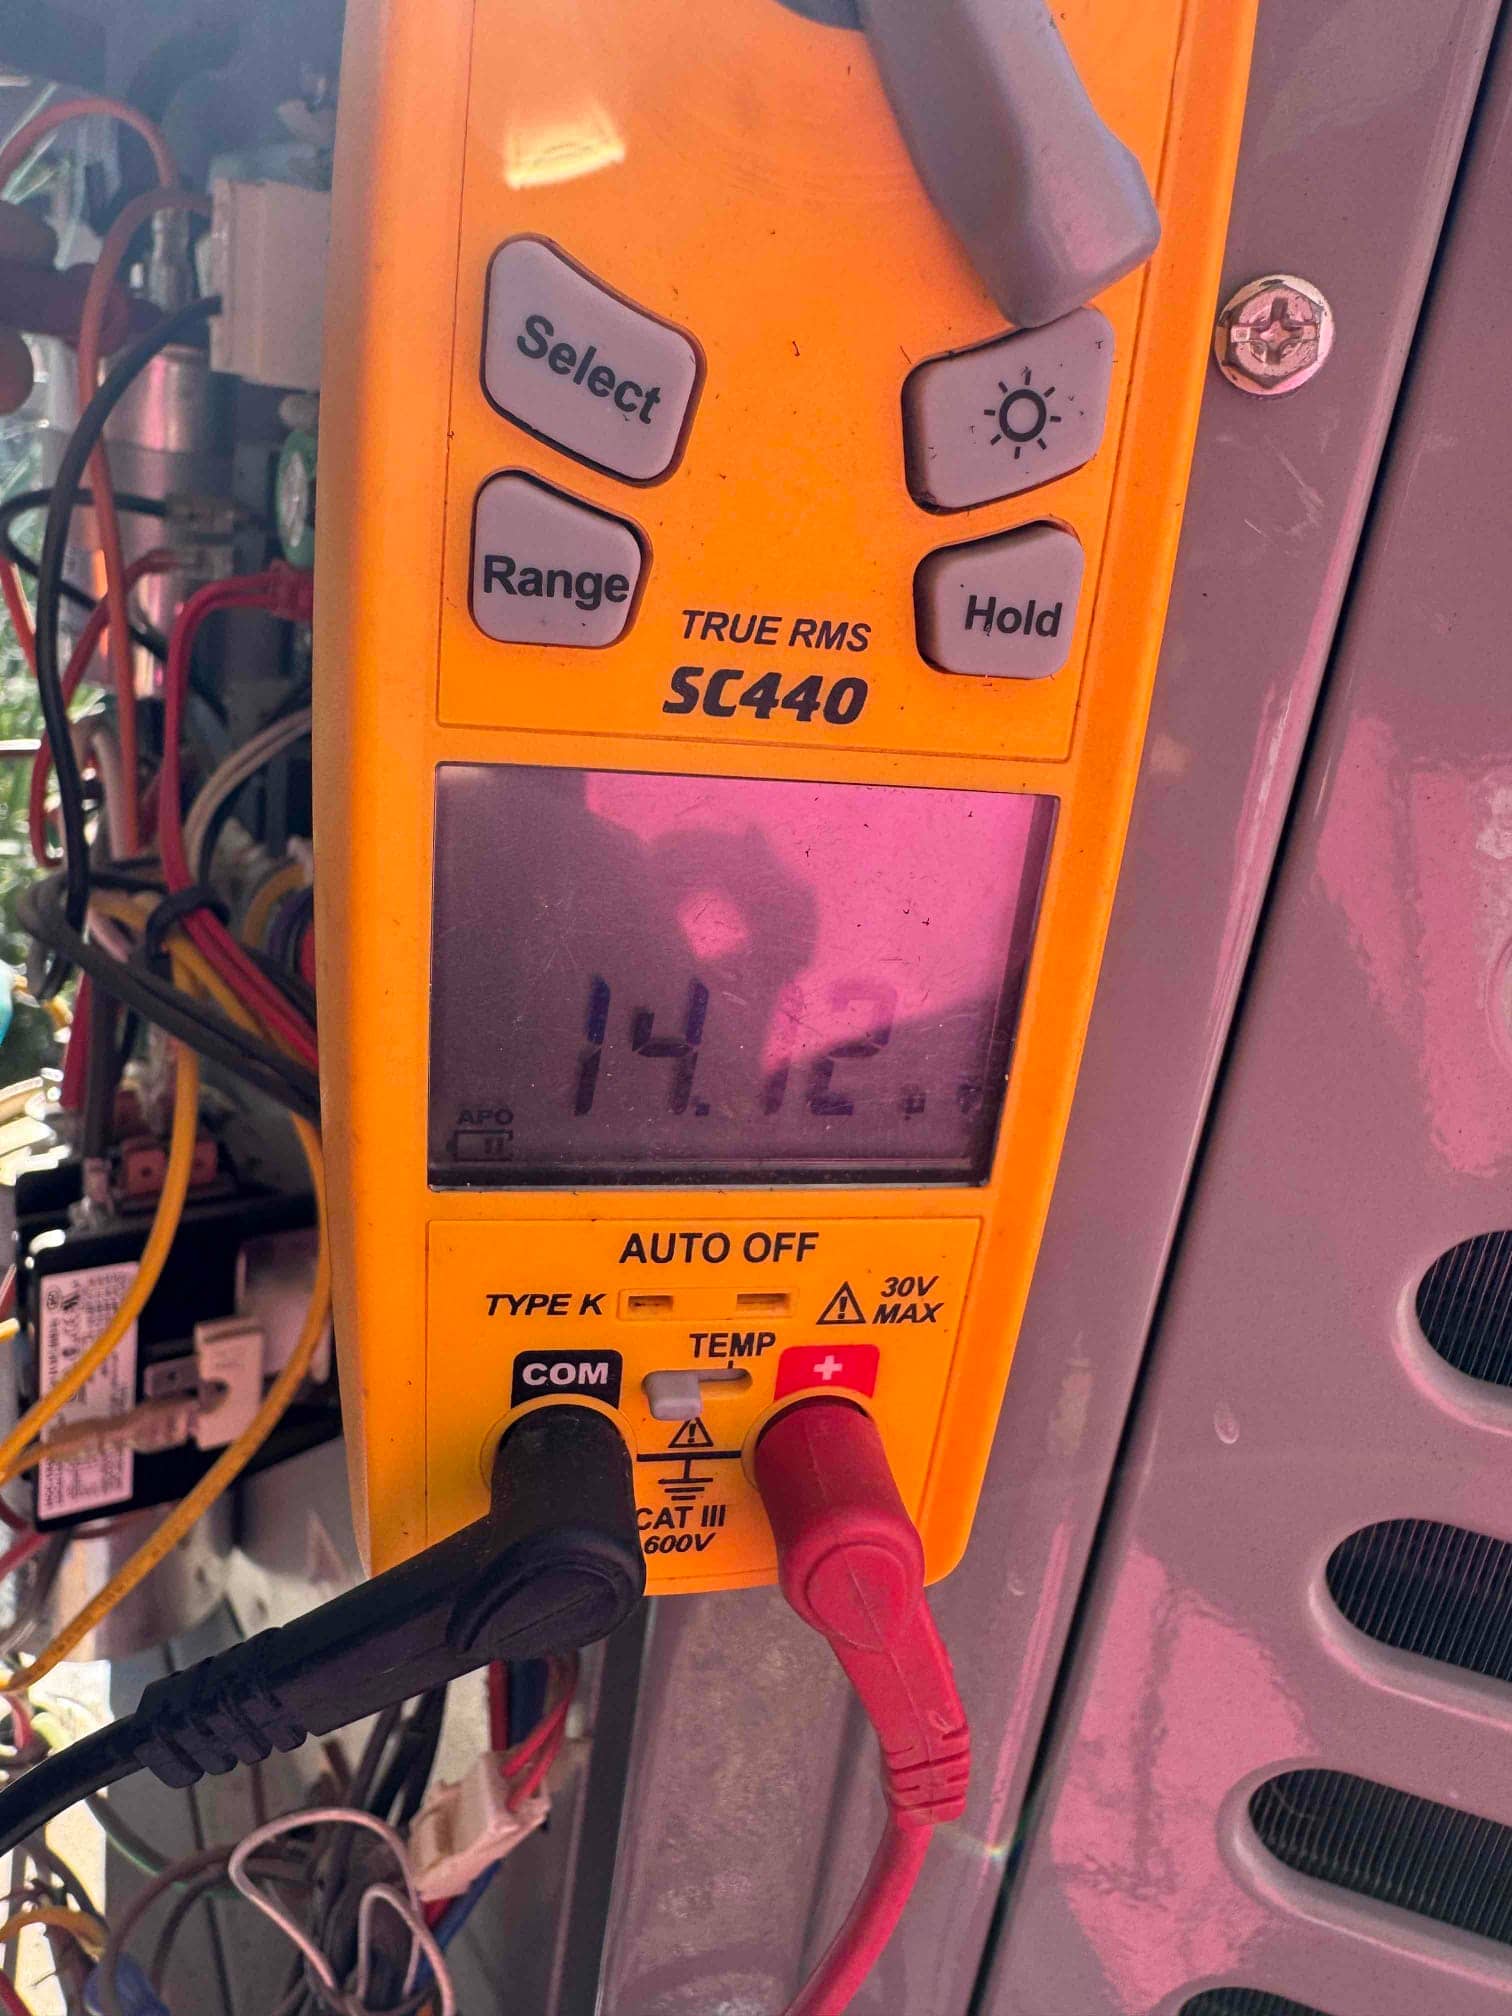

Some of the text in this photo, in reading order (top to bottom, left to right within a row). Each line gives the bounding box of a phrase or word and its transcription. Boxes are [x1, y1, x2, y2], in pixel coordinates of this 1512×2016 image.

[515, 314, 662, 425] Select
[483, 553, 630, 611] Range
[963, 594, 1063, 638] Hold
[681, 610, 872, 653] TRUE RMS
[662, 665, 870, 726] SC440
[619, 1231, 819, 1264] AUTO OFF
[880, 1276, 940, 1297] 30V
[486, 1294, 607, 1317] TYPE K
[873, 1302, 943, 1324] MAX
[689, 1332, 776, 1358] TEMP
[521, 1361, 609, 1386] COM
[636, 1504, 726, 1531] CAT III
[643, 1532, 717, 1555] 600V
